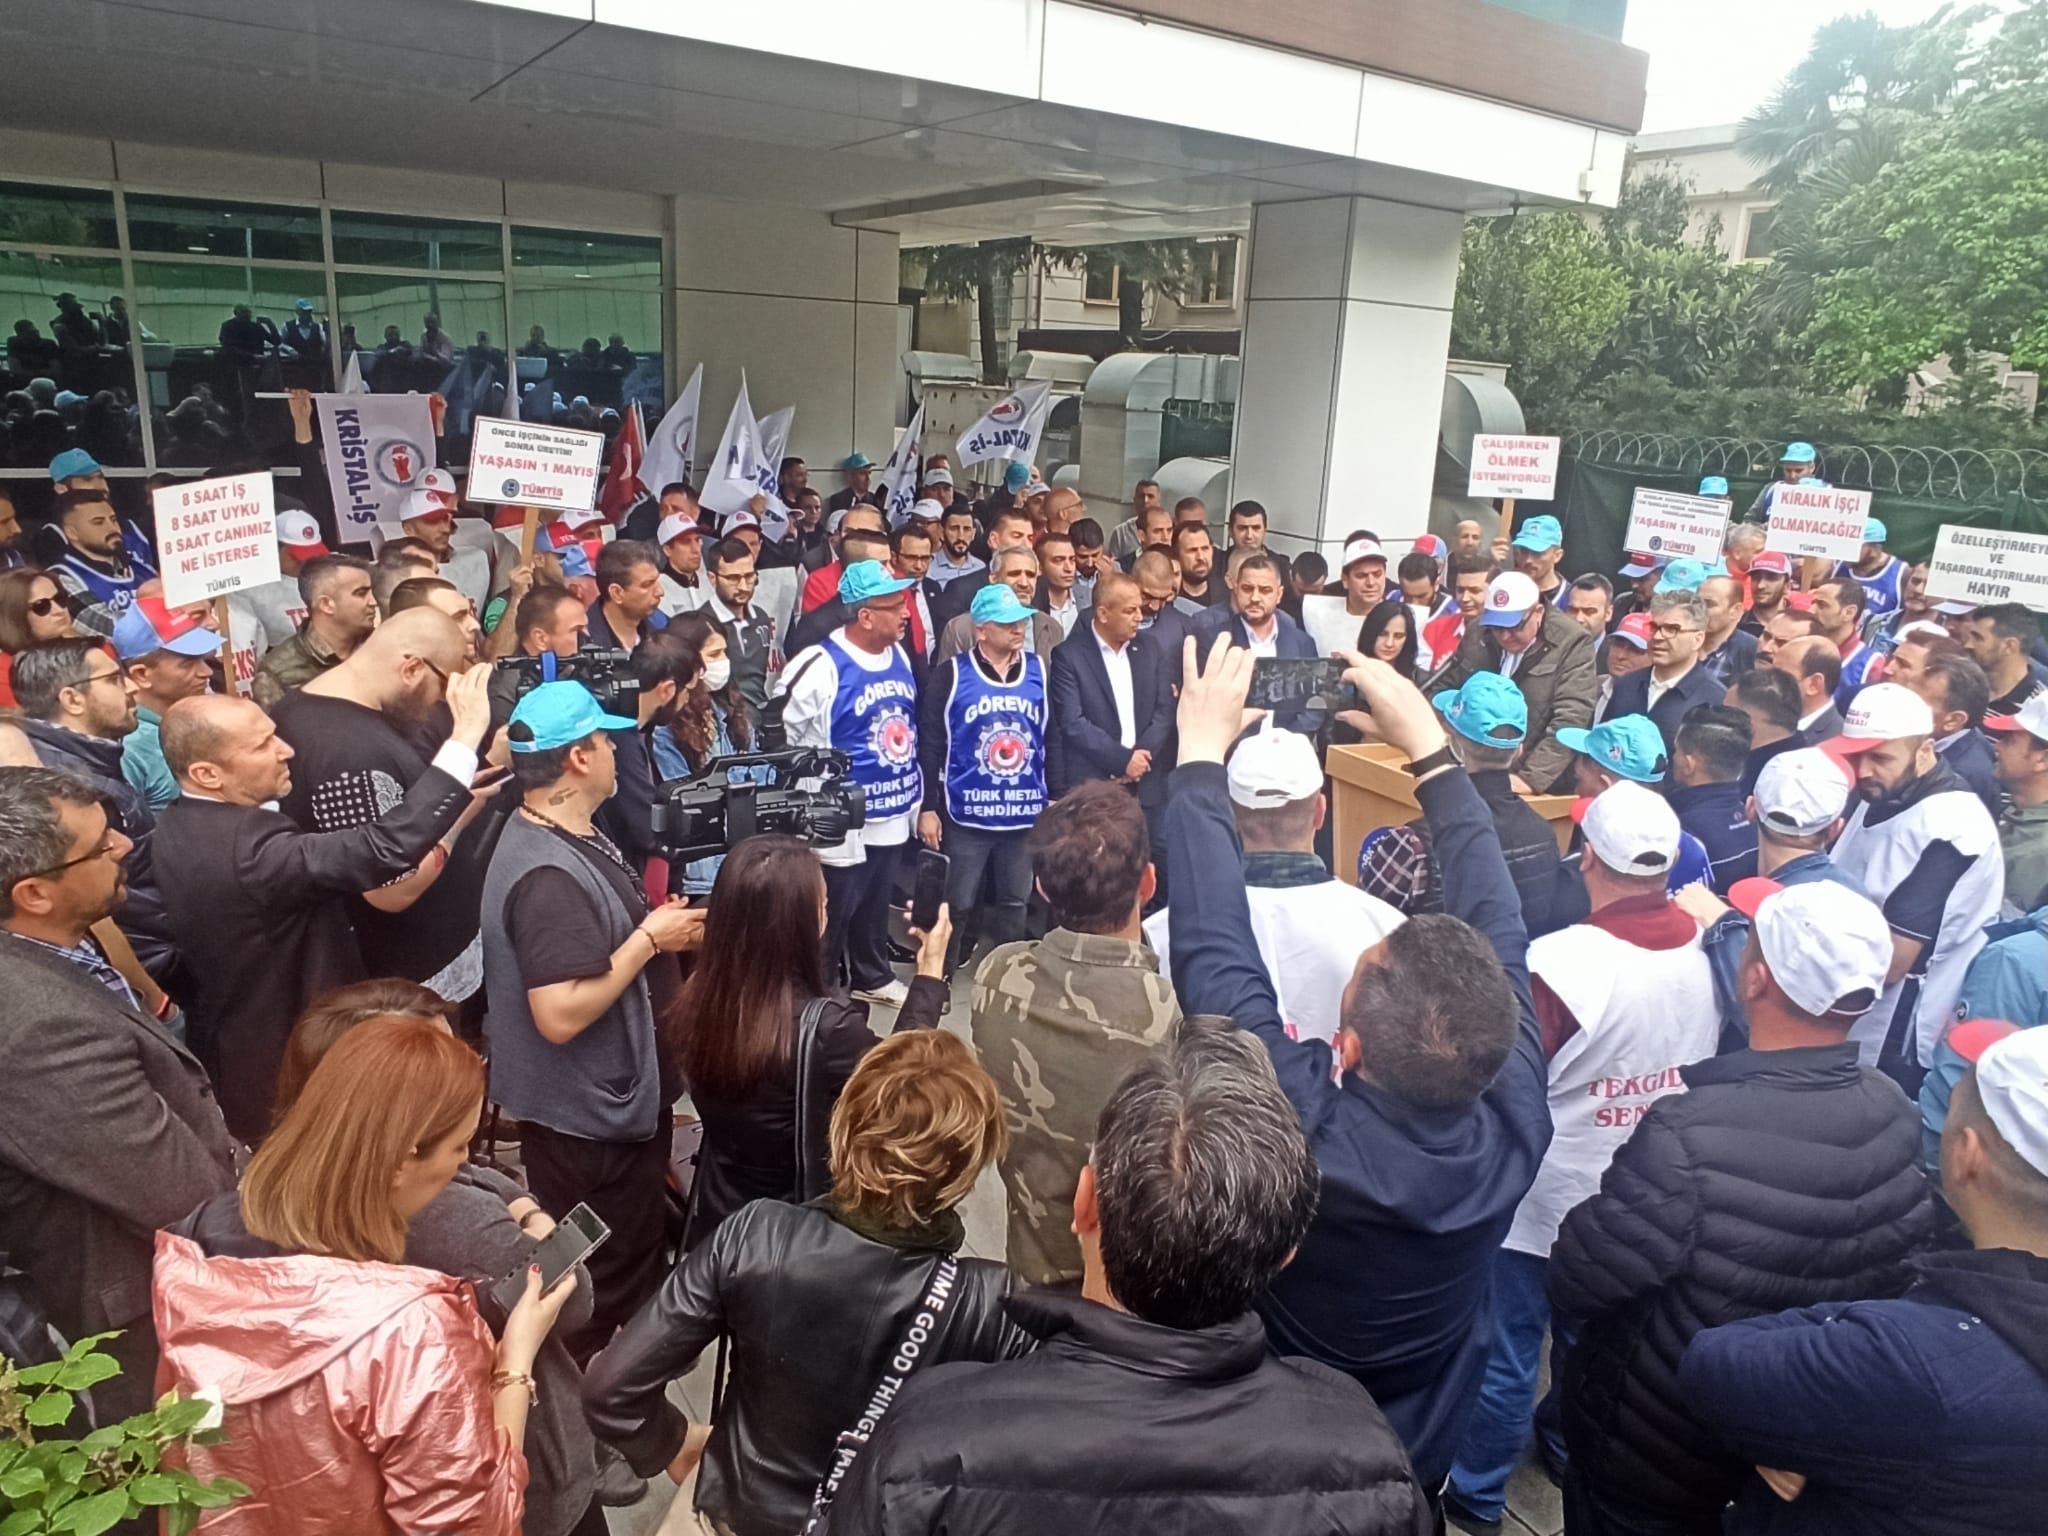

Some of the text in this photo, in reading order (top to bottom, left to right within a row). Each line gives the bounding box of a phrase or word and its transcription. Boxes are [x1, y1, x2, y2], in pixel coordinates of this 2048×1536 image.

[491, 427, 516, 438] ÖNCE
[504, 441, 534, 452] SONRA
[1481, 439, 1550, 450] ÇALIŞIRKEN
[335, 409, 380, 524] KRİSTAL-İŞ
[478, 454, 594, 478] YAŞASIN 1 MAYIS
[1488, 453, 1540, 468] ÖLMEK
[182, 481, 246, 506] 8 SAAT İŞ
[521, 483, 563, 497] TÜMTİS
[1781, 489, 1860, 514] KİRALIK İŞÇİ
[171, 502, 260, 531] 8 SAAT UYKU
[1634, 515, 1721, 538] YAŞASIN 1 MAYIS
[164, 521, 272, 555] 8 SAAT CANIMIZ
[1771, 517, 1862, 539] OLMAYACAĞIZ!
[181, 544, 260, 574] NE İSTERSE
[1989, 553, 2005, 564] VE
[206, 576, 241, 592] TÜMTİS
[1966, 581, 2011, 598] HAYIR
[862, 779, 902, 797] TÜRK
[963, 788, 1043, 802] TÜRK METAL
[964, 803, 1043, 817] SENDİKASI
[925, 1260, 958, 1312] TIME
[893, 1312, 935, 1372] GOOD
